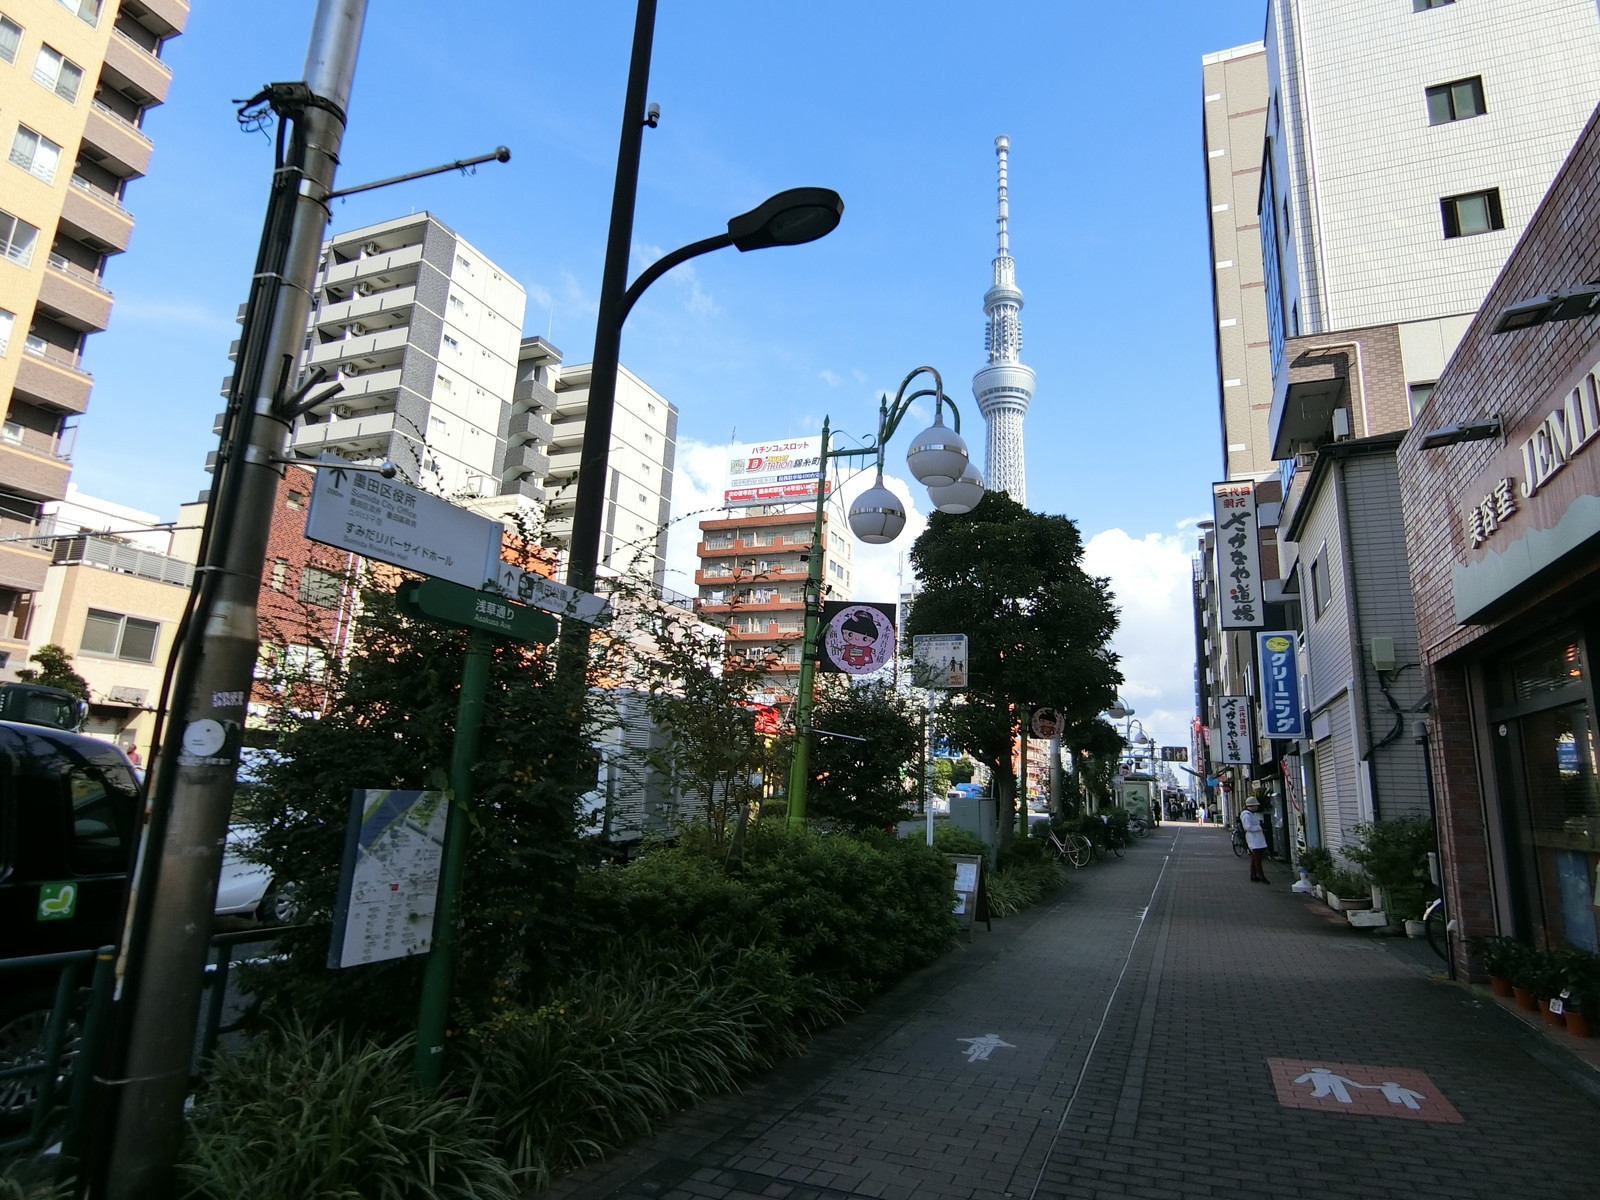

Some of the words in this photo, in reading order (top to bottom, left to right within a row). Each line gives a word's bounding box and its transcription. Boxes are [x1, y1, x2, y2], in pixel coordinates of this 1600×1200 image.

[752, 441, 809, 454] パチンコ&スロット
[351, 488, 380, 505] Sumida
[381, 499, 396, 511] City
[397, 505, 417, 519] Office
[353, 472, 417, 508] 墨田区役所
[1217, 486, 1251, 498] 三代目
[1467, 476, 1517, 550] 美容室
[345, 521, 454, 566] すみだリバーサイドホール
[1220, 511, 1256, 622] さかなや道場
[473, 613, 499, 628] Asakusa
[475, 598, 515, 620] 浅草通り
[1271, 653, 1295, 733] クリーニング
[1221, 698, 1241, 762] さかなや道場
